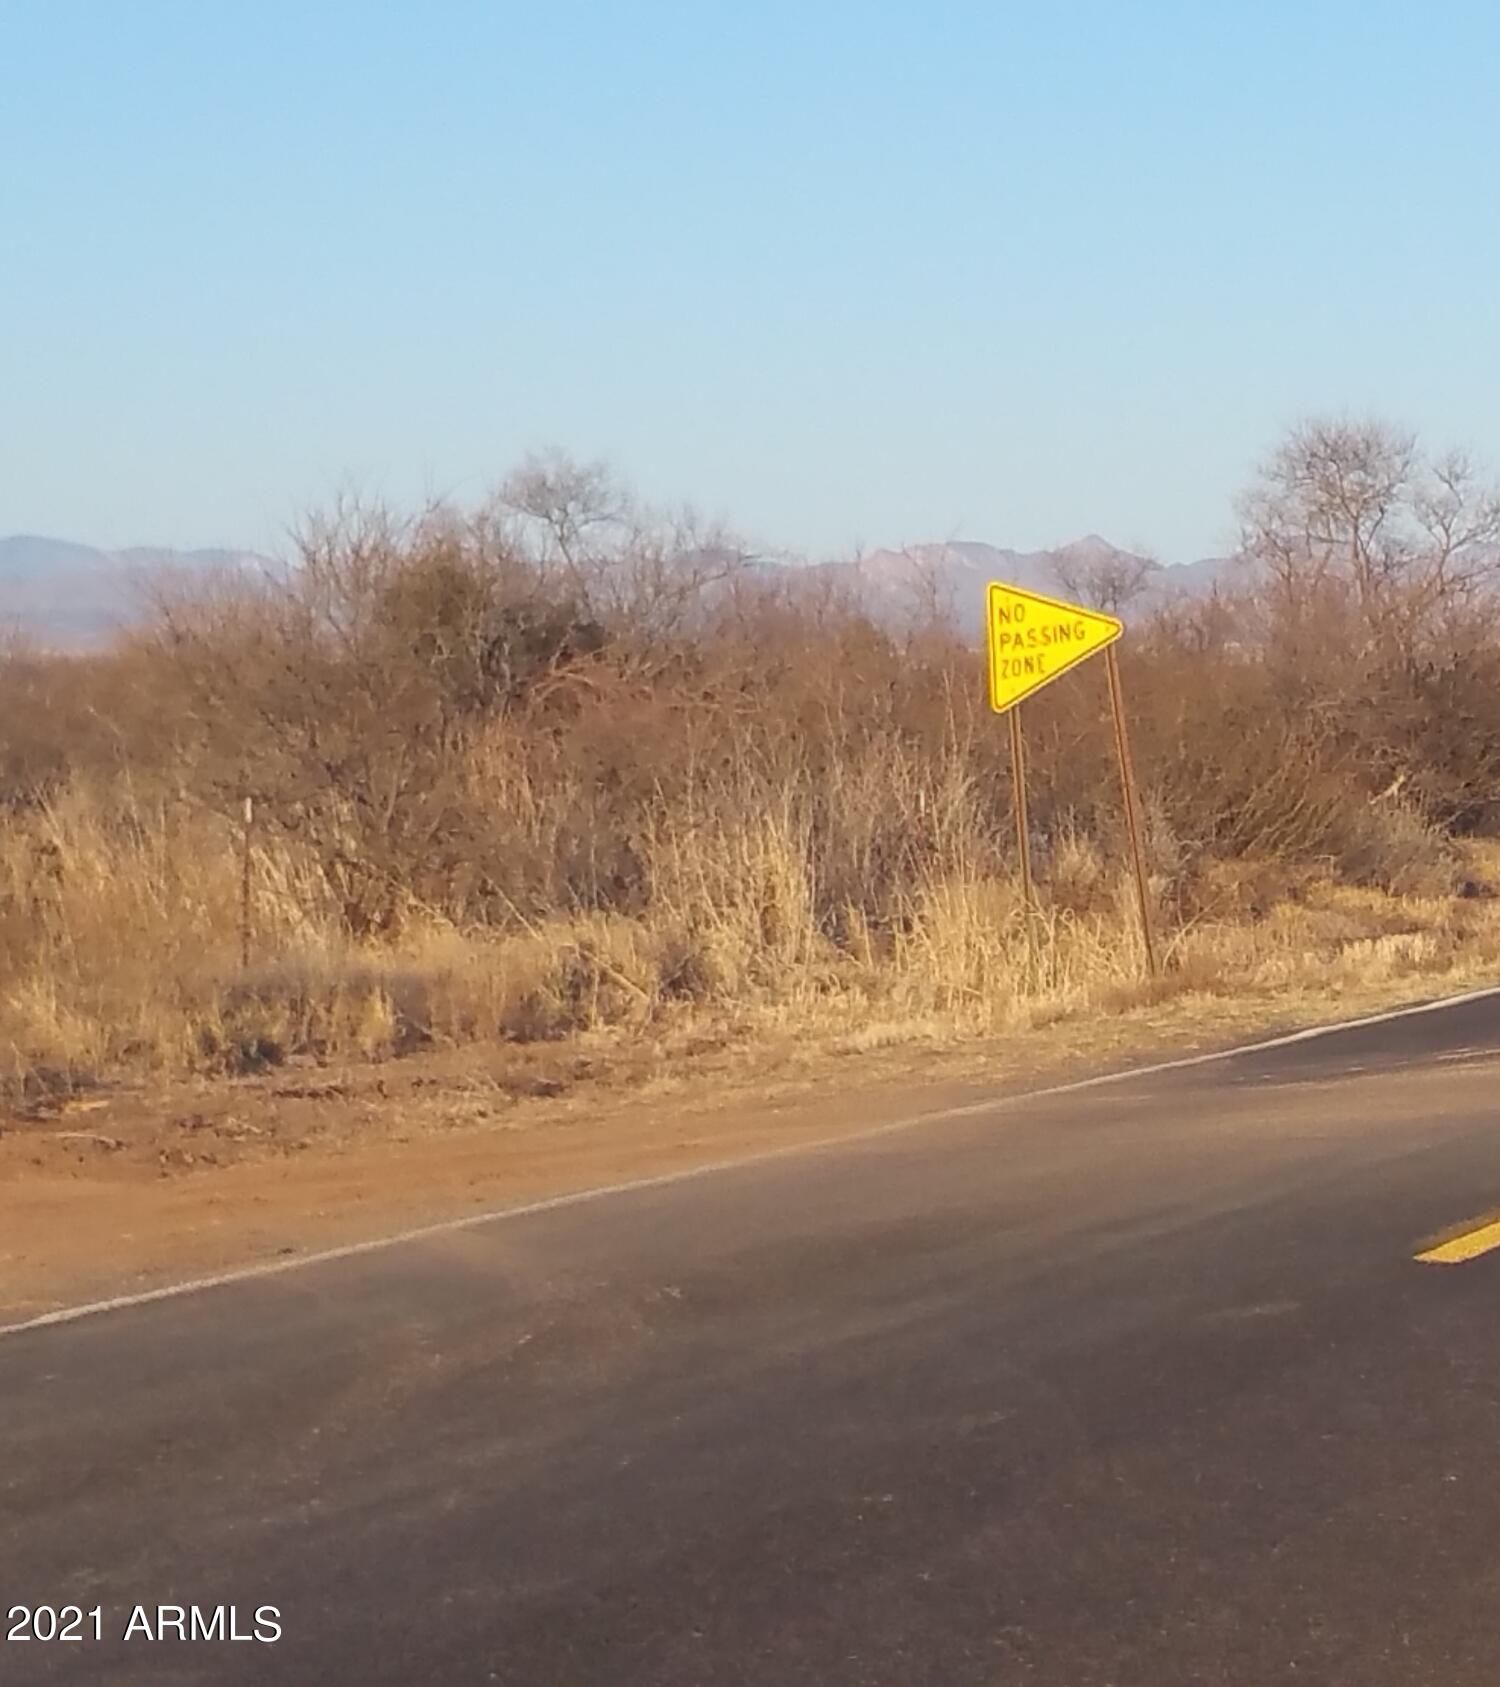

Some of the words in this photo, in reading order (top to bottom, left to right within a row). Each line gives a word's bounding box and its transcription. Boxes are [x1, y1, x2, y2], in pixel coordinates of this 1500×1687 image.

[999, 604, 1025, 624] NO
[1000, 621, 1085, 650] PASSING
[1001, 654, 1046, 679] ZONE
